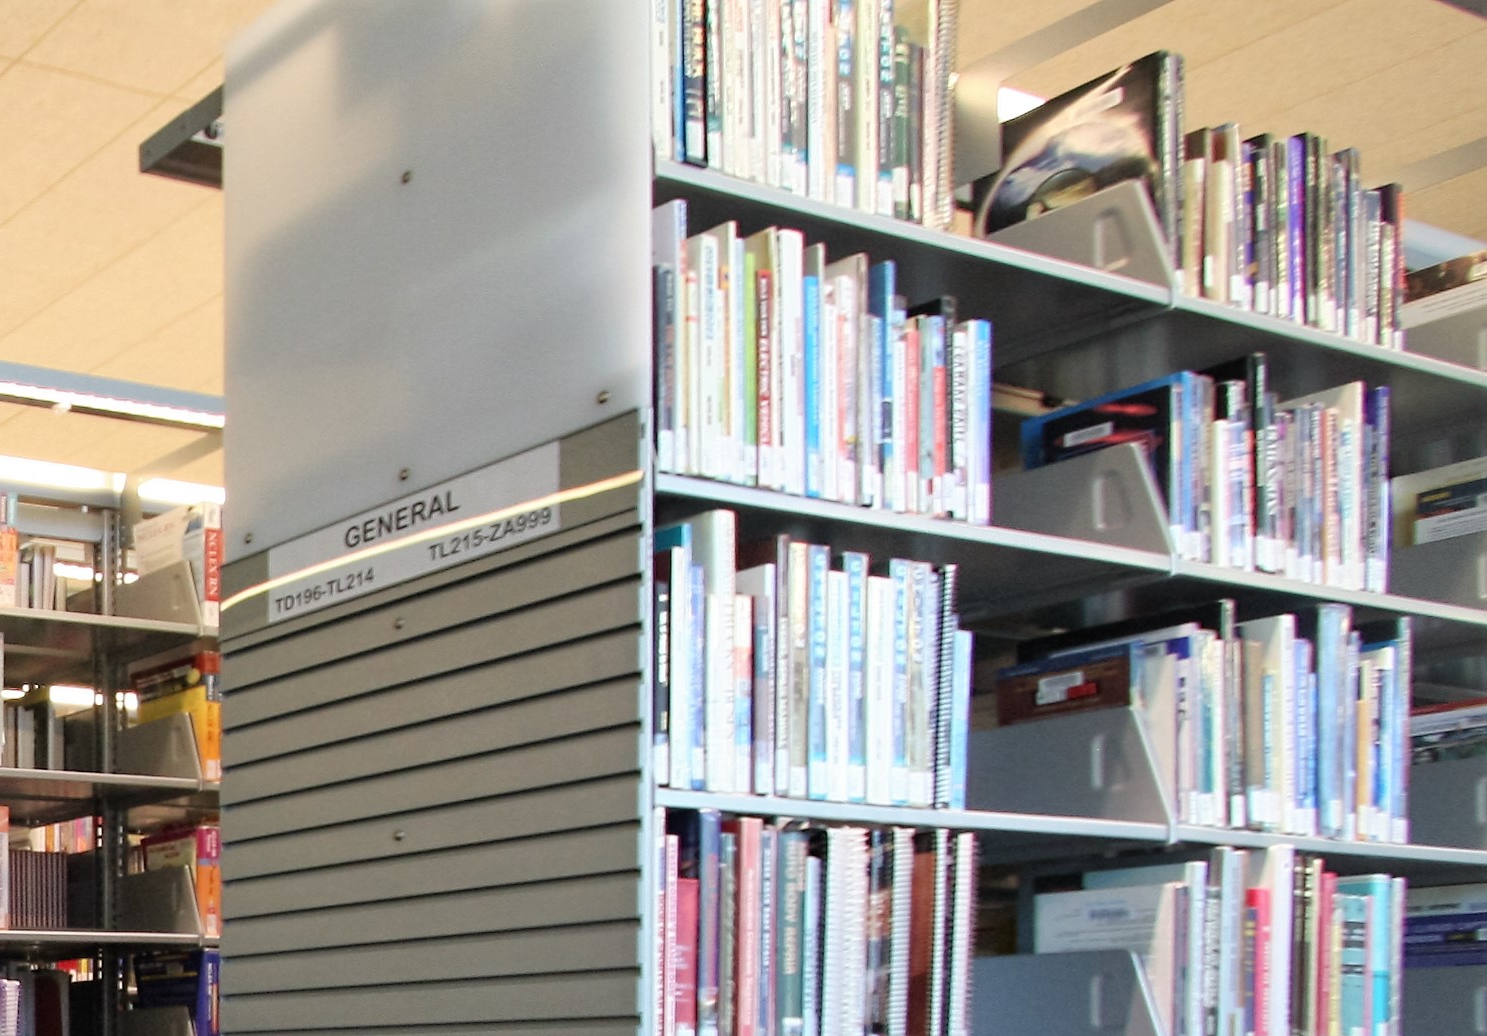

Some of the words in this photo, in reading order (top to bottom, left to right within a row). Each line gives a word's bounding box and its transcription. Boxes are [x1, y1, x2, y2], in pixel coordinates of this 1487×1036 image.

[760, 338, 769, 394] ELECTRIC
[345, 490, 459, 548] GENERAL
[429, 507, 552, 561] TL215-ZA999
[275, 568, 375, 613] TD196-TL214
